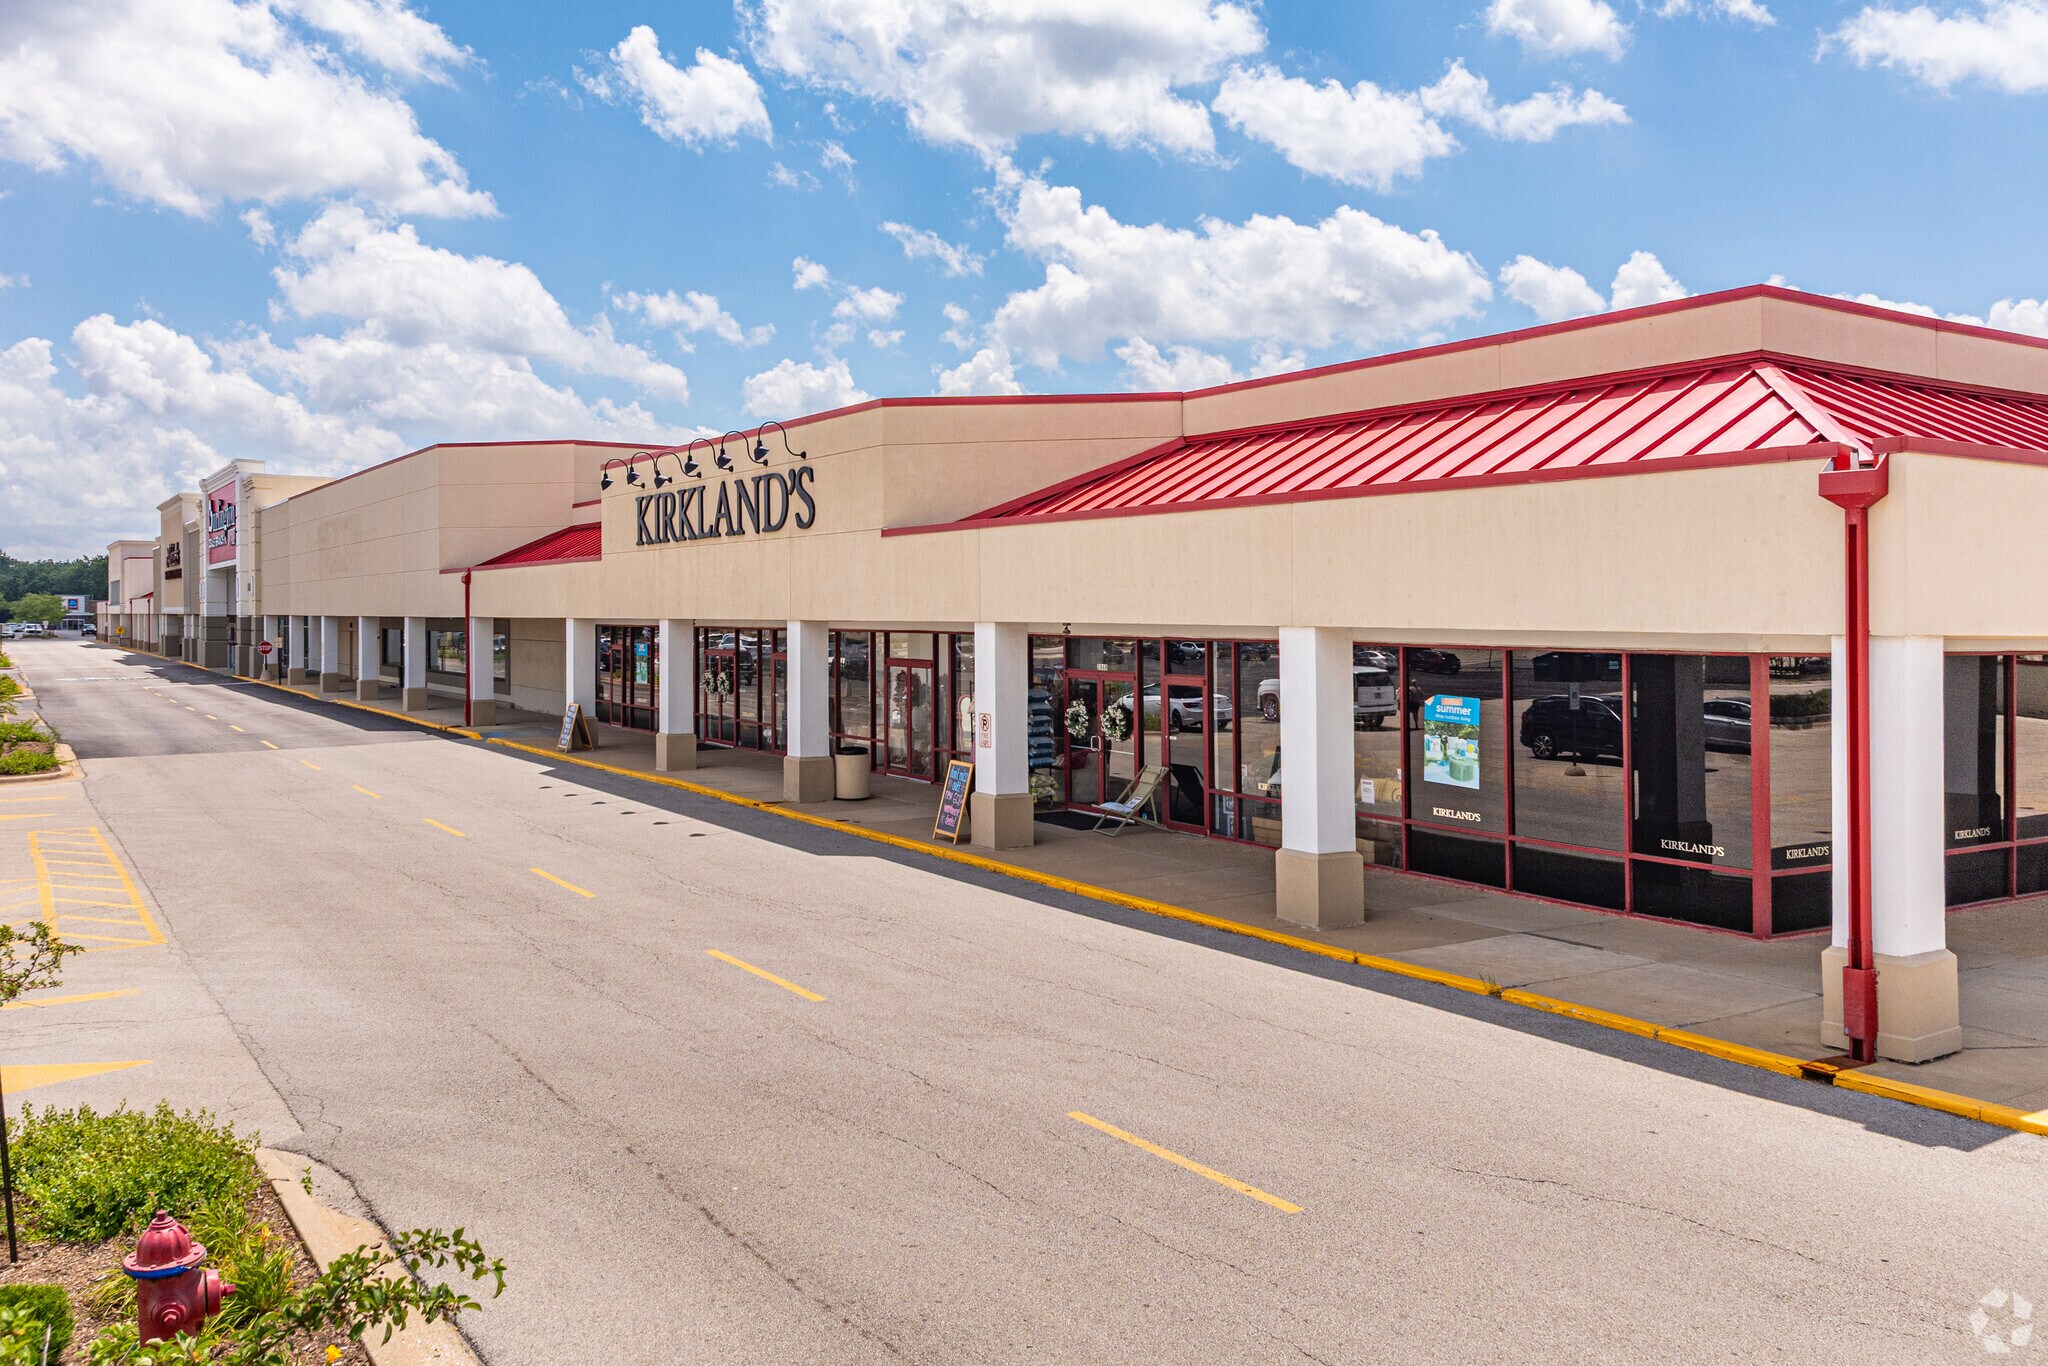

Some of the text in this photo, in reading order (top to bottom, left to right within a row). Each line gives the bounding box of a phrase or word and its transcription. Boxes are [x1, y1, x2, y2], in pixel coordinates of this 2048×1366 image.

[635, 466, 816, 546] KIRKLAND'S
[1436, 704, 1471, 716] summer
[1433, 807, 1481, 822] KIRKLAND'S
[1955, 826, 1991, 840] KIRKLAND'S
[1661, 839, 1724, 857] KIRKLAND'S
[1786, 846, 1830, 859] KIRKLAND'S
